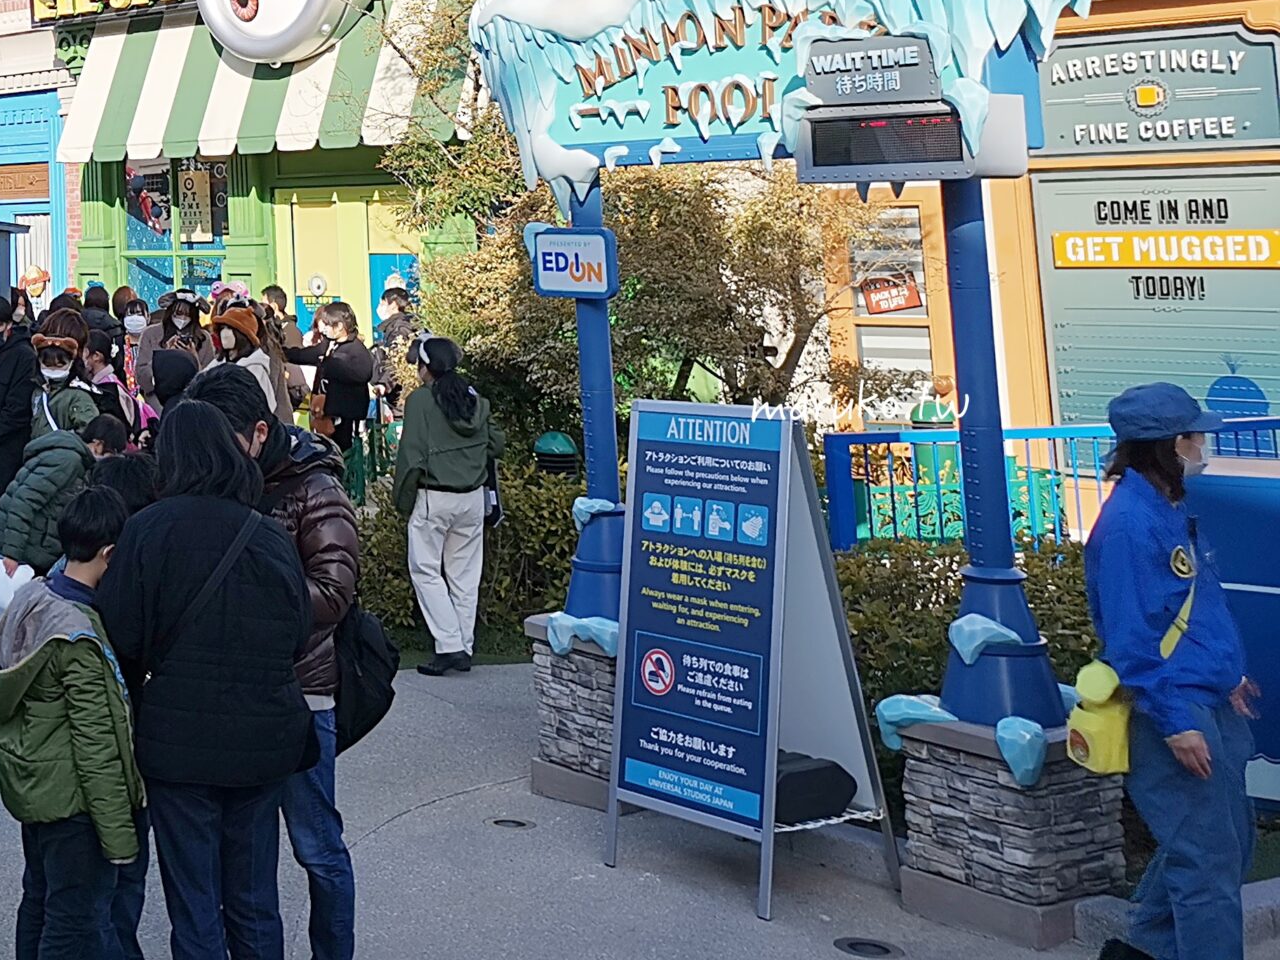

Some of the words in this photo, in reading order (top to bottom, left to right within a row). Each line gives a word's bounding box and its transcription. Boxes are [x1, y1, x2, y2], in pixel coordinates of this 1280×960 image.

[575, 4, 746, 97] MINION
[810, 51, 865, 75] WAIT
[867, 46, 920, 70] TIME
[1051, 48, 1246, 85] ARRESTINGLY
[835, 71, 901, 96] 待ち時間
[1074, 122, 1129, 145] FINE
[1138, 116, 1236, 141] COFFEE
[1095, 200, 1152, 225] COME
[1158, 199, 1179, 224] IN
[1186, 198, 1229, 224] AND
[1065, 236, 1124, 262] GET
[1132, 235, 1270, 262] MUGGED
[541, 251, 603, 284] EDION
[1129, 275, 1206, 300] TODAY!
[666, 416, 751, 445] ATTENTION
[646, 465, 664, 475] Please
[665, 467, 684, 477] follow
[684, 469, 695, 478] the
[695, 471, 730, 482] precautions
[730, 475, 749, 483] below
[750, 476, 768, 485] when
[664, 478, 701, 489] experiencing
[702, 482, 713, 490] our
[641, 587, 665, 600] Always
[666, 592, 683, 601] wear
[690, 596, 708, 607] mask
[709, 600, 728, 610] when
[651, 601, 677, 614] waiting
[690, 608, 704, 617] and
[705, 611, 749, 628] experiencing
[682, 654, 749, 679] 待ち列での食事は
[677, 684, 696, 696] Please
[696, 689, 717, 700] refrain
[717, 693, 732, 704] from
[733, 697, 753, 710] eating
[650, 727, 736, 759] ご協力をお願いします
[639, 739, 659, 752] Thank
[660, 744, 673, 757] you
[674, 748, 685, 759] for
[686, 751, 701, 763] your
[702, 757, 747, 776] cooperation.
[648, 778, 681, 796] UNIVERSAL
[683, 788, 711, 804] STUDIOS
[712, 798, 734, 810] JAPAN
[658, 770, 678, 783] ENJOY
[680, 775, 698, 788] YOUR
[700, 781, 714, 792] DAY
[714, 786, 724, 796] AT
